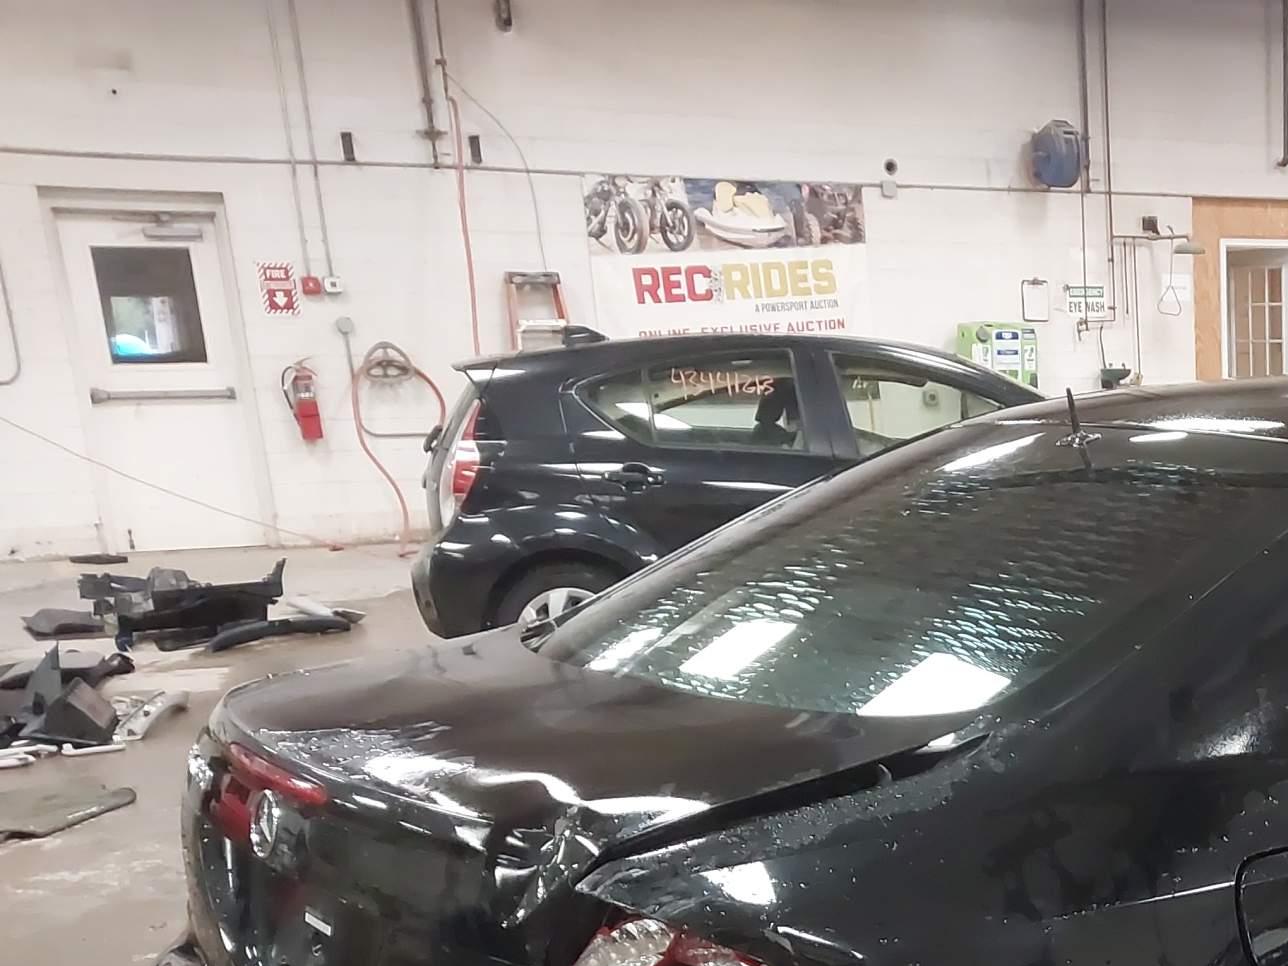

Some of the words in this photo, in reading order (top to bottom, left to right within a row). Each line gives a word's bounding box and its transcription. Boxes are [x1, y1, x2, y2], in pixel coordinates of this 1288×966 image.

[632, 265, 714, 304] REC
[721, 258, 838, 300] RIDES
[755, 303, 760, 313] A
[761, 302, 808, 313] POWERSPORT
[809, 300, 839, 310] AUCTION
[1069, 301, 1082, 313] EYE
[1085, 301, 1105, 313] WASH
[787, 318, 846, 334] AUCTION
